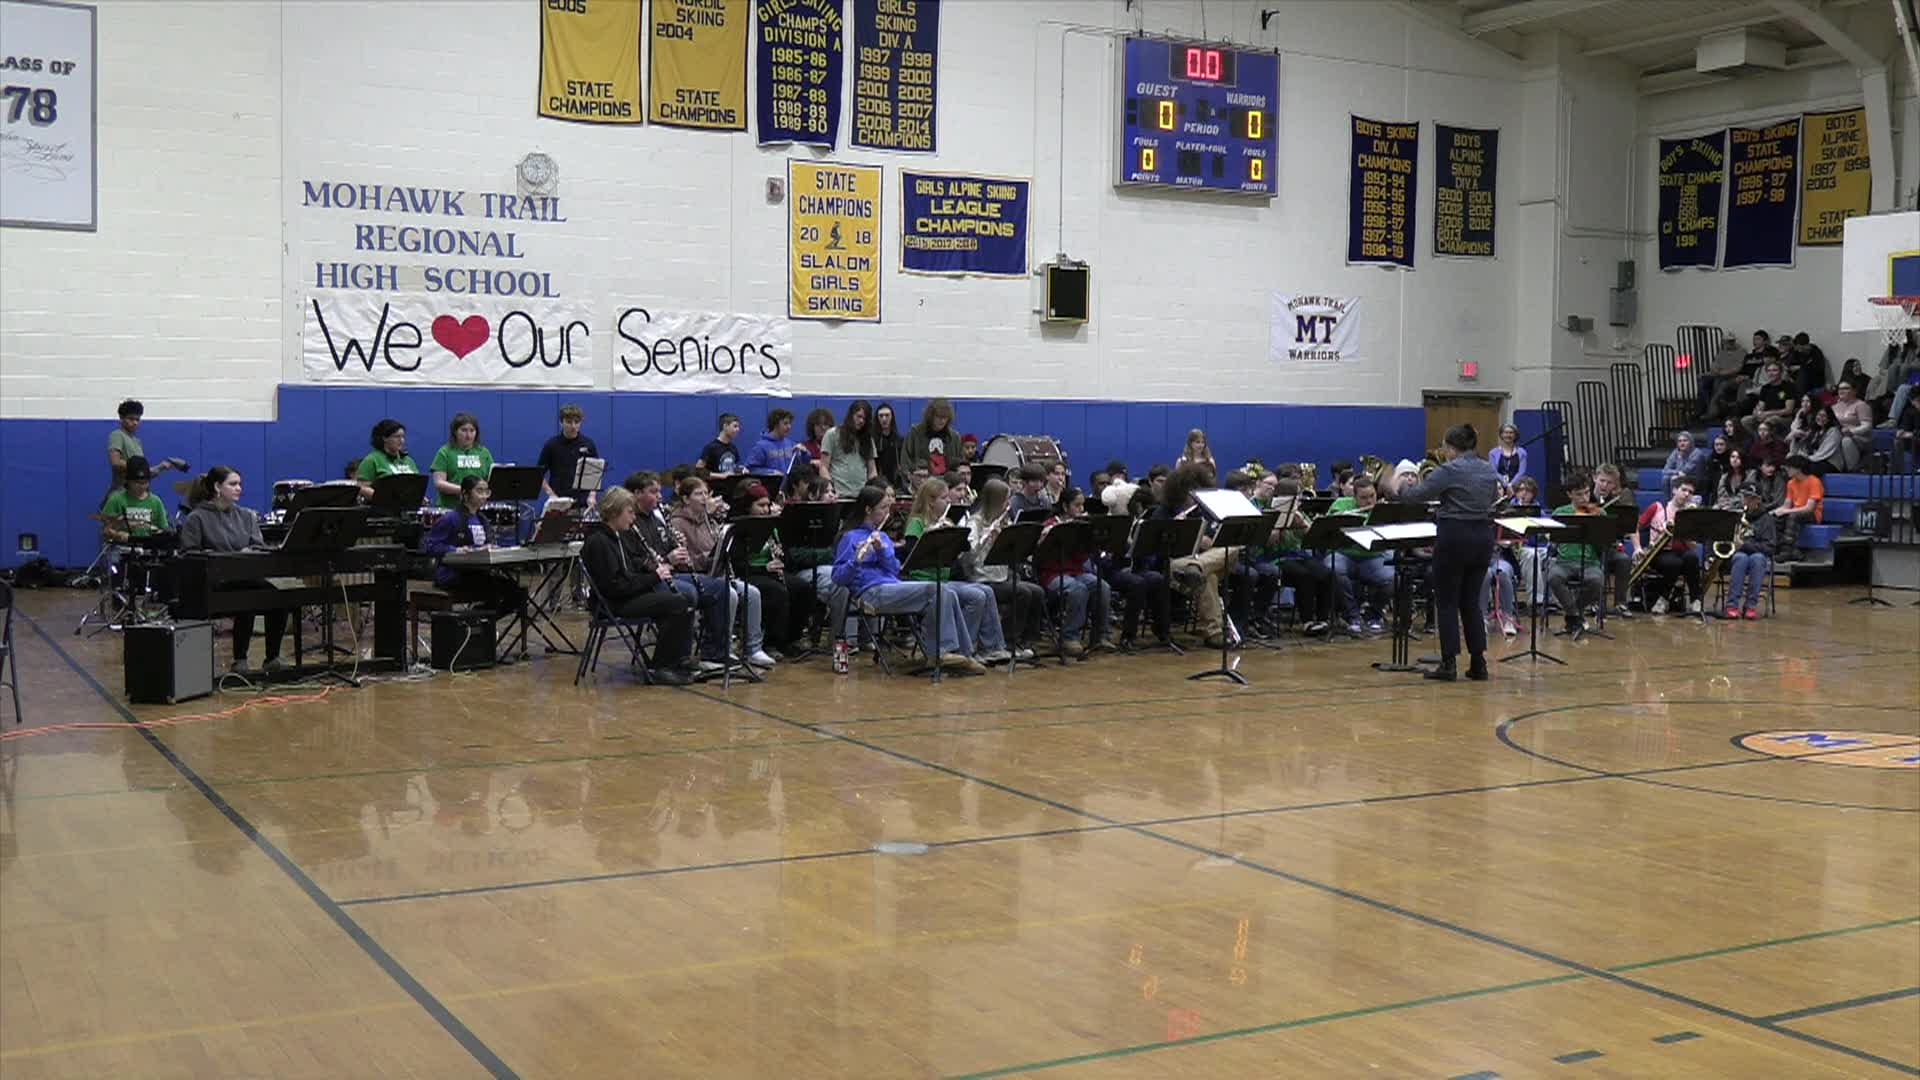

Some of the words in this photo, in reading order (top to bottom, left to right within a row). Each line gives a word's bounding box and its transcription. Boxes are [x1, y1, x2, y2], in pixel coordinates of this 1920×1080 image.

[548, 0, 586, 14] 2005
[676, 7, 725, 26] SKIING
[877, 0, 916, 16] GIRLS
[656, 23, 693, 40] 2004
[779, 13, 827, 33] CHAMPS
[875, 14, 916, 32] SKIING
[764, 27, 826, 48] DIVISION
[833, 37, 841, 52] A
[904, 35, 912, 49] A
[772, 47, 827, 68] 1985-86
[860, 46, 890, 64] 1997
[901, 51, 932, 67] 1998
[1187, 48, 1219, 79] 0.0
[50, 61, 76, 75] OF
[772, 65, 827, 84] 1986-87
[860, 62, 890, 80] 1999
[899, 68, 932, 84] 2000
[567, 80, 614, 98] STATE
[676, 89, 720, 106] STATE
[773, 83, 827, 103] 1987-88
[857, 81, 888, 97] 2001
[898, 85, 932, 101] 2002
[1136, 82, 1178, 98] GUEST
[0, 85, 57, 127] 78
[549, 97, 631, 116] CHAMPIONS
[773, 99, 827, 119] 1988-89
[857, 98, 891, 115] 2006
[898, 102, 933, 118] 2007
[1226, 92, 1266, 108] WARRIORS
[660, 104, 736, 123] CHAMPIONS
[1159, 101, 1174, 130] 0
[1826, 115, 1856, 130] BOYS
[774, 114, 827, 133] 1989-90
[857, 114, 891, 131] 2008
[898, 119, 930, 134] 2014
[1184, 122, 1219, 136] PERIOD
[1248, 111, 1262, 138] 0
[1356, 120, 1381, 136] BOYS
[1386, 126, 1416, 139] SKIING
[1732, 130, 1760, 143] BOYS
[1763, 122, 1797, 140] SKIING
[859, 129, 931, 148] CHAMPIONS
[1133, 136, 1159, 147] FOULS
[1454, 133, 1480, 147] BOYS
[1821, 129, 1861, 145] ALPINE
[1243, 147, 1266, 157] FOULS
[1391, 141, 1399, 155] A
[1449, 148, 1484, 162] ALPINE
[1661, 144, 1684, 172] BOYS
[1691, 139, 1722, 166] SKIING
[1747, 141, 1780, 157] STATE
[1822, 144, 1857, 160] SKIING
[1142, 148, 1154, 170] 0
[1358, 153, 1411, 173] CHAMPIONS
[1734, 155, 1792, 175] CHAMPIONS
[1251, 158, 1262, 180] 0
[1451, 163, 1481, 177] SKIING
[1659, 173, 1684, 186] STATE
[1687, 171, 1722, 184] CHAMPS
[816, 171, 856, 192] STATE
[915, 179, 944, 196] GIRLS
[949, 182, 982, 198] ALPINE
[986, 184, 1017, 200] SKIING
[1472, 179, 1479, 189] A
[302, 181, 465, 216] MOHAWK
[480, 193, 567, 222] TRAIL
[799, 195, 872, 218] CHAMPIONS
[930, 199, 1001, 217] LEAGUE
[916, 217, 1015, 237] CHAMPIONS
[1679, 217, 1715, 231] CHAMPS
[1807, 225, 1843, 240] CHAMP
[355, 224, 525, 258] REGIONAL
[800, 227, 819, 242] 20
[855, 230, 871, 245] 18
[1439, 239, 1490, 254] CHAMPIONS
[801, 255, 870, 271] SLALOM
[315, 262, 398, 291] HIGH
[424, 267, 560, 298] SCHOOL
[811, 275, 860, 291] GIRLS
[808, 297, 862, 312] SKIING
[1287, 296, 1320, 311] MOHAWK
[312, 298, 422, 371] We
[499, 310, 590, 368] Our
[1295, 314, 1337, 343] MT
[617, 307, 780, 379] Seniors
[1288, 349, 1340, 361] WARRIORS
